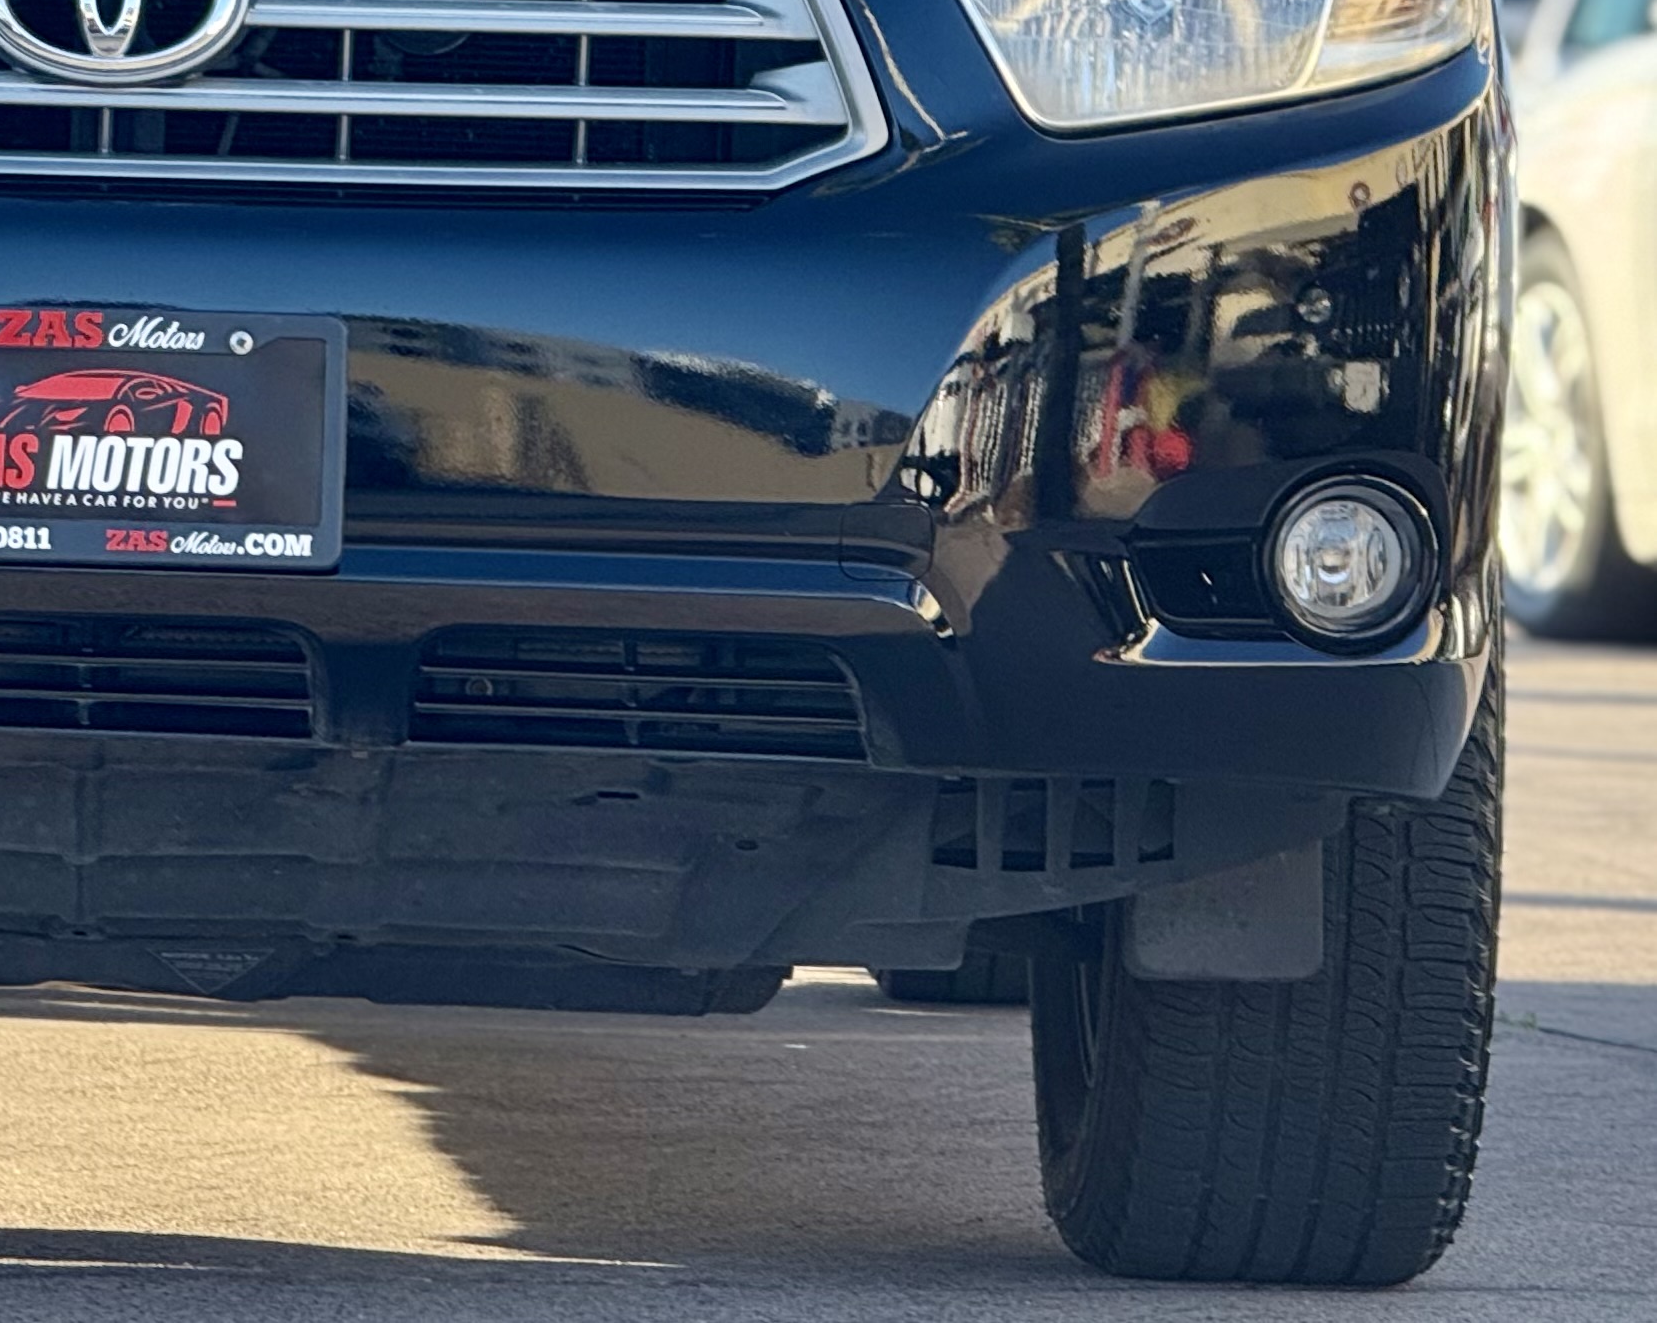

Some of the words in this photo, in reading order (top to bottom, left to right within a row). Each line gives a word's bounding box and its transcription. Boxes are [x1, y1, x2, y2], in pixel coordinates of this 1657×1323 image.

[108, 315, 206, 350] Motors
[46, 434, 243, 496] MOTORS
[15, 492, 62, 506] HAVE
[65, 493, 78, 506] A
[82, 493, 118, 508] CAR
[122, 495, 158, 509] FOR
